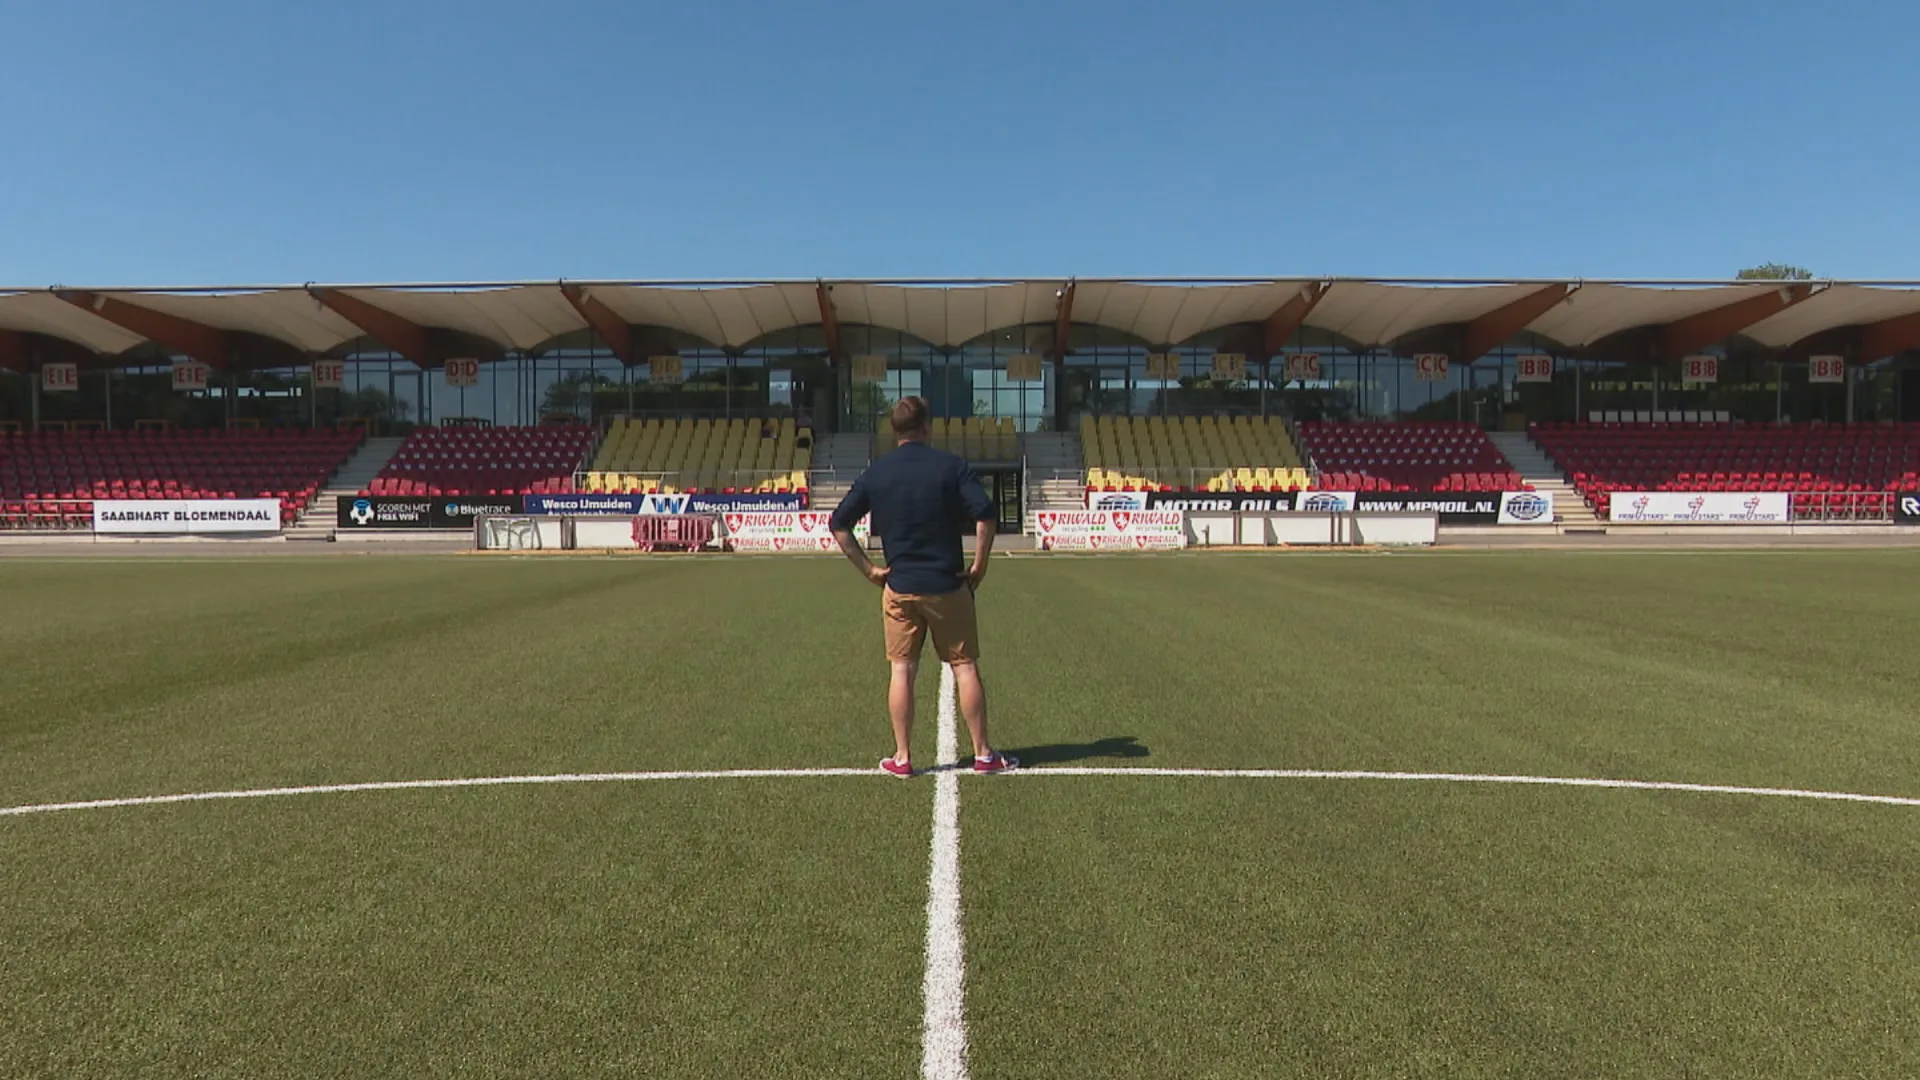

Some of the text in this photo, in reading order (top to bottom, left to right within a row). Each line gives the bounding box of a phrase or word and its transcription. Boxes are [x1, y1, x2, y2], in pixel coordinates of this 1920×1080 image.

[377, 503, 432, 513] SCOREN MET
[460, 503, 511, 515] Bluetrace
[542, 498, 579, 510] Wesco
[693, 501, 730, 512] Wesco
[1154, 499, 1290, 511] MOTOR OILS
[1359, 501, 1496, 513] WWW.MPMOIL.NL
[101, 510, 271, 521] SAABHART BLOEMENDAAL
[744, 513, 794, 526] RIWALD
[1058, 512, 1106, 525] RIWALD
[1131, 512, 1180, 525] RIWALD
